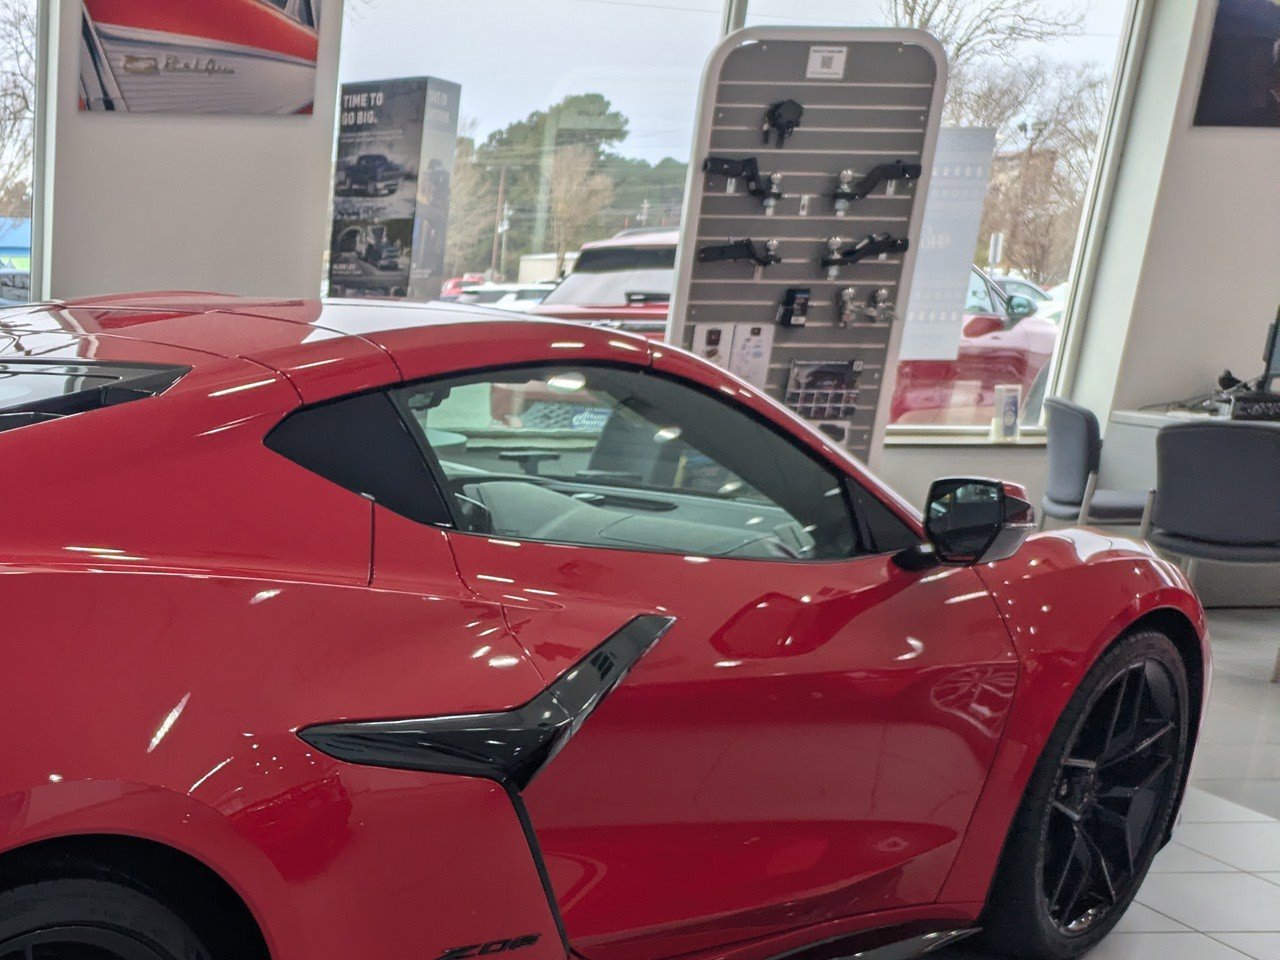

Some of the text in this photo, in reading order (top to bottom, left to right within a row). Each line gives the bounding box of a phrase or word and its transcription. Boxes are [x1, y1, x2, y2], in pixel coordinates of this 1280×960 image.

[343, 92, 384, 109] TIME TO
[356, 110, 378, 125] BIG.
